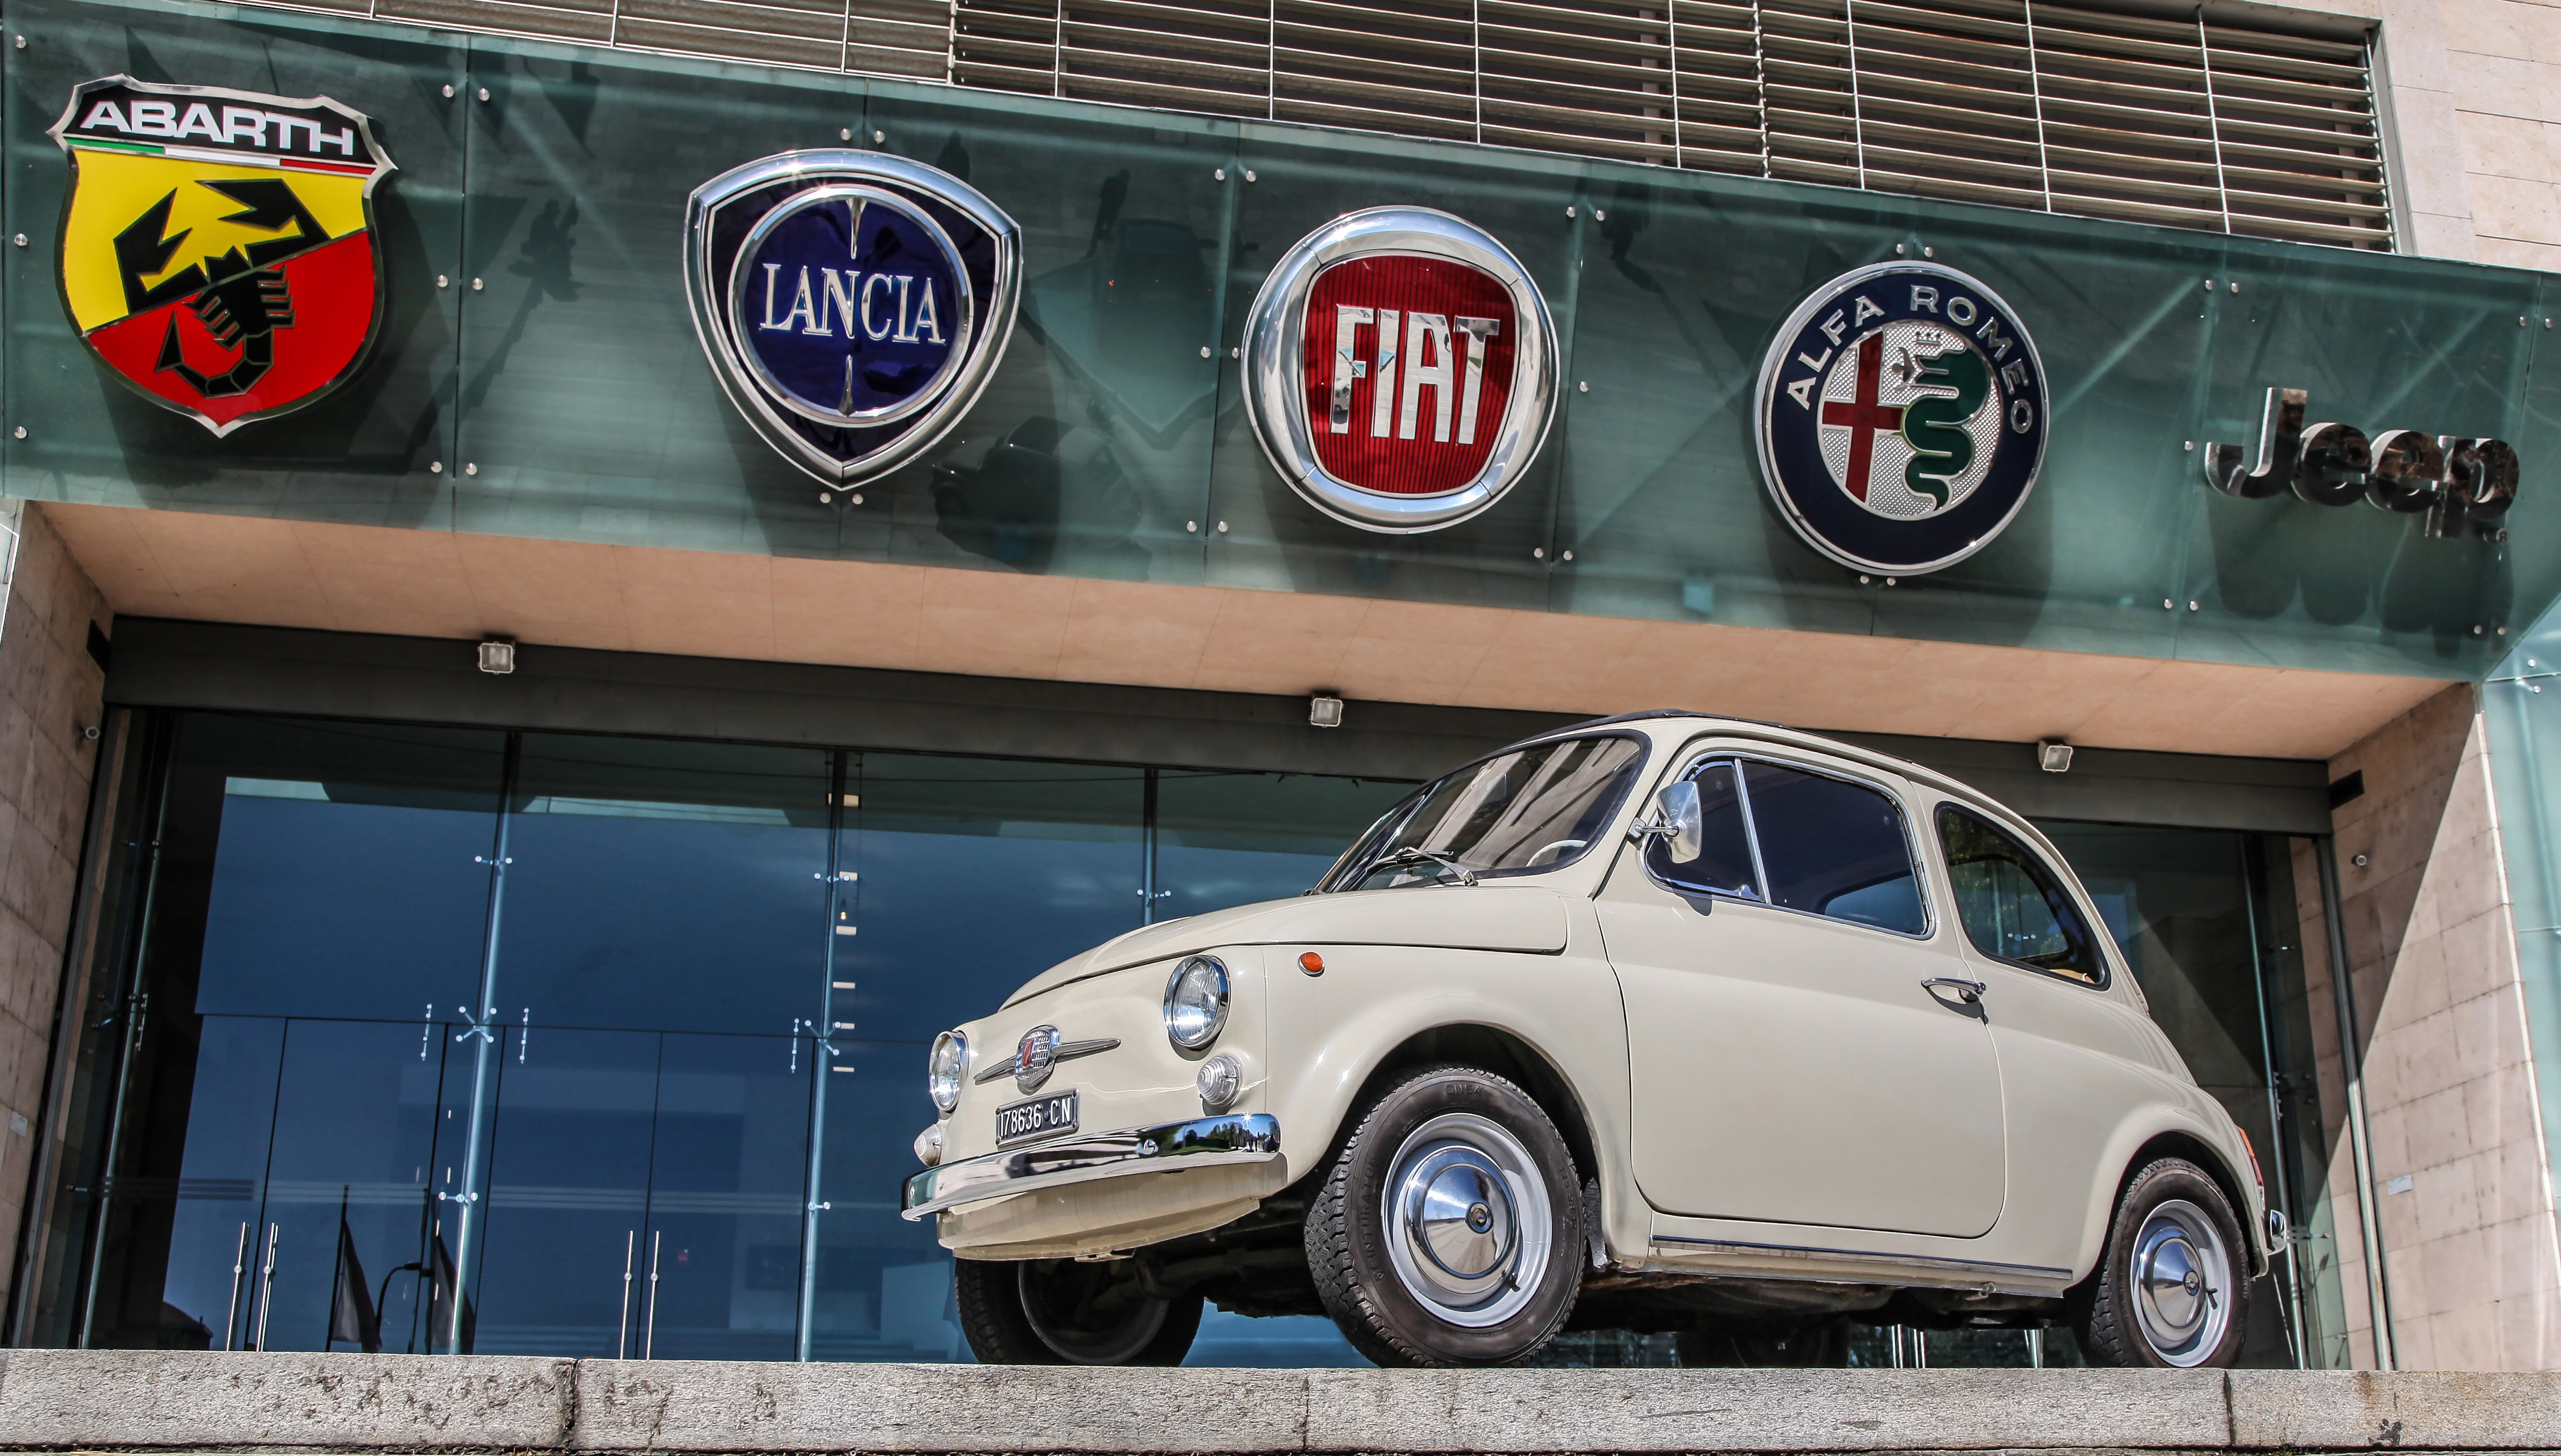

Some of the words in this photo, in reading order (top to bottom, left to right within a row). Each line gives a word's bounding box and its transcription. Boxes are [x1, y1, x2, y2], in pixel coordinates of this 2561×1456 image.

[81, 101, 353, 155] ABARTH
[759, 263, 947, 346] LANCIA
[1787, 295, 1885, 410] ALFA
[1910, 284, 2033, 434] ROMEO
[1330, 304, 1500, 445] FIAT
[2205, 387, 2519, 539] Jeep
[1000, 1103, 1041, 1137] 178636
[1050, 1097, 1071, 1125] CN
